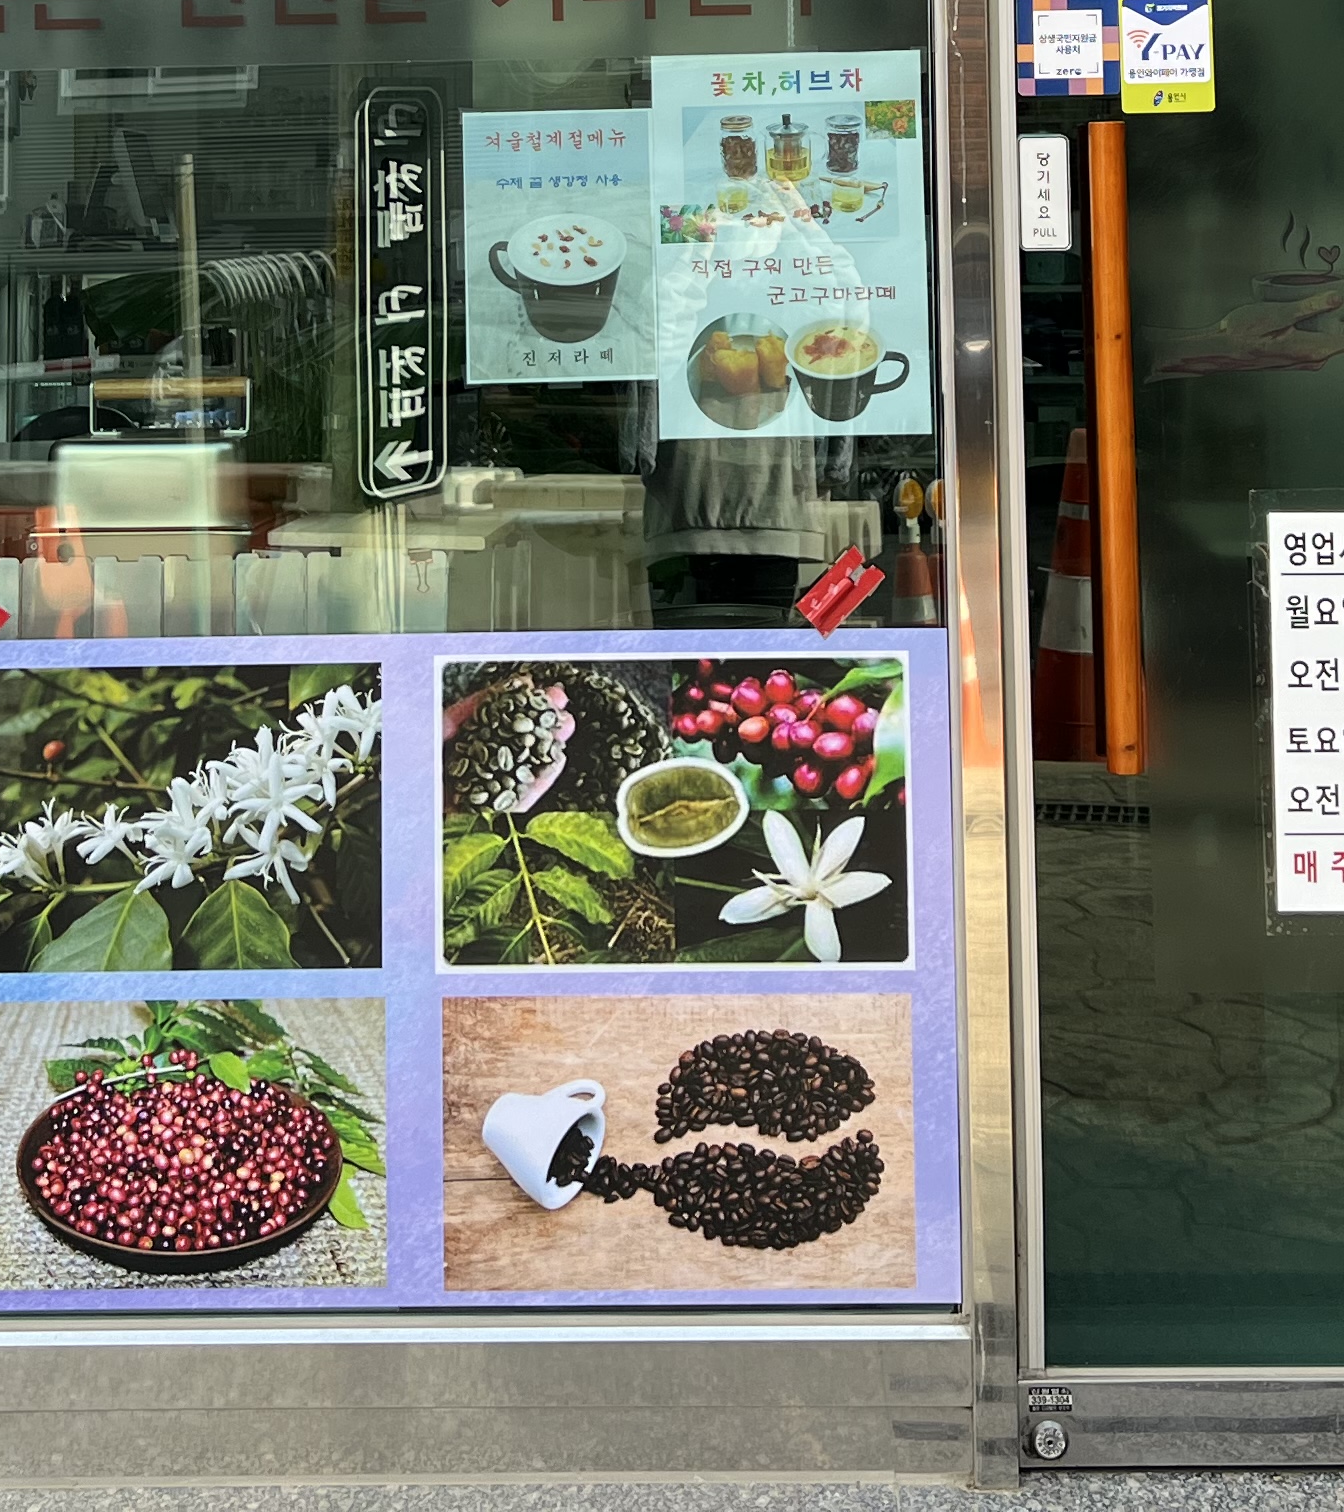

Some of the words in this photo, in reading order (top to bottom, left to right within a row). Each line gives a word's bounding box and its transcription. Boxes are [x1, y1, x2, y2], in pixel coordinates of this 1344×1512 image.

[1032, 227, 1057, 238] PULL
[691, 257, 732, 279] 직접
[743, 257, 783, 278] 구워
[792, 255, 834, 277] 만든
[1293, 850, 1318, 884] 매
